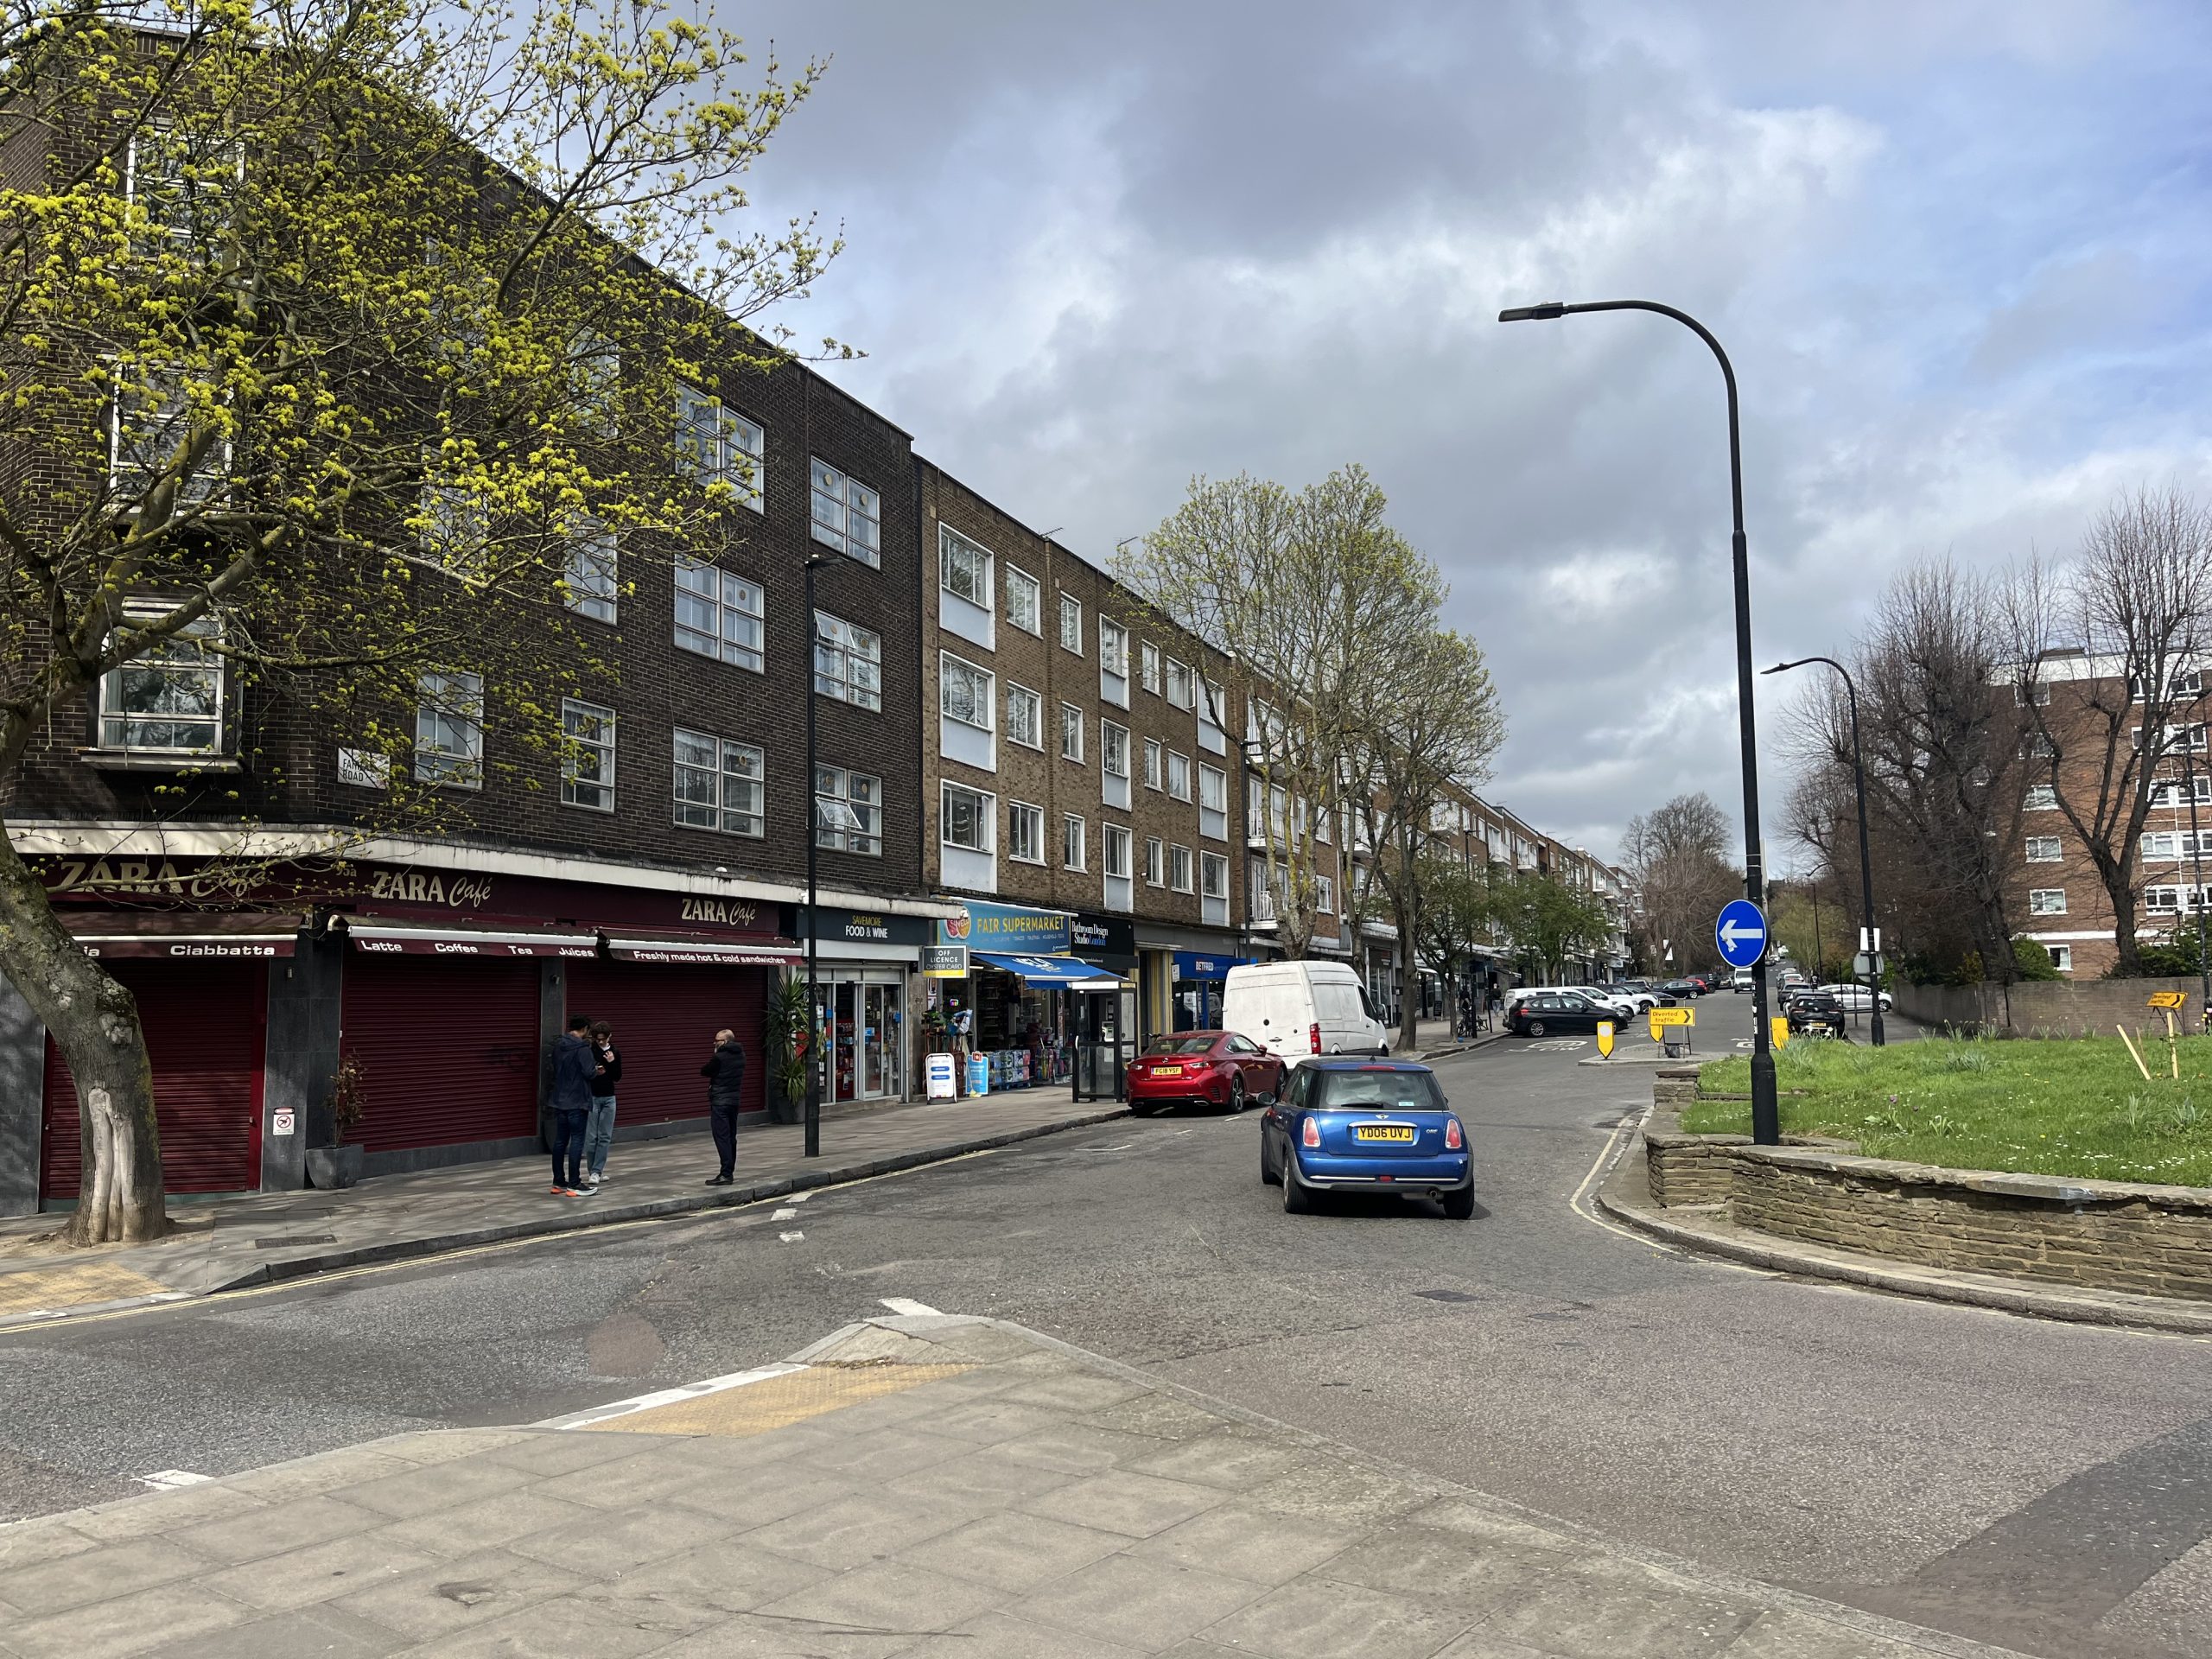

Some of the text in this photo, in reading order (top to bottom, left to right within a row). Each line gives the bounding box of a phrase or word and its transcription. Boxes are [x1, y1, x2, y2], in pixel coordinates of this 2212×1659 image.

[342, 769, 363, 782] ROAD
[60, 861, 184, 893] ZARA
[372, 871, 493, 908] ZARA Café
[681, 899, 757, 926] ZARA Café
[851, 915, 881, 927] SAVEMORE
[977, 918, 1000, 934] FAIR
[1002, 915, 1065, 933] SUPERMARKET
[845, 925, 888, 938] FOOD & WINE
[1071, 920, 1109, 939] Bathroom Design
[1074, 932, 1090, 945] Studio
[1089, 933, 1106, 947] London
[169, 944, 276, 957] Ciabbatta
[360, 939, 595, 958] Latte Coffee Tea Juices
[632, 950, 787, 965] Freshly made hot & cold sandwiches
[1195, 960, 1214, 972] BETFRED
[1359, 1127, 1412, 1139] YD06 UVJ
